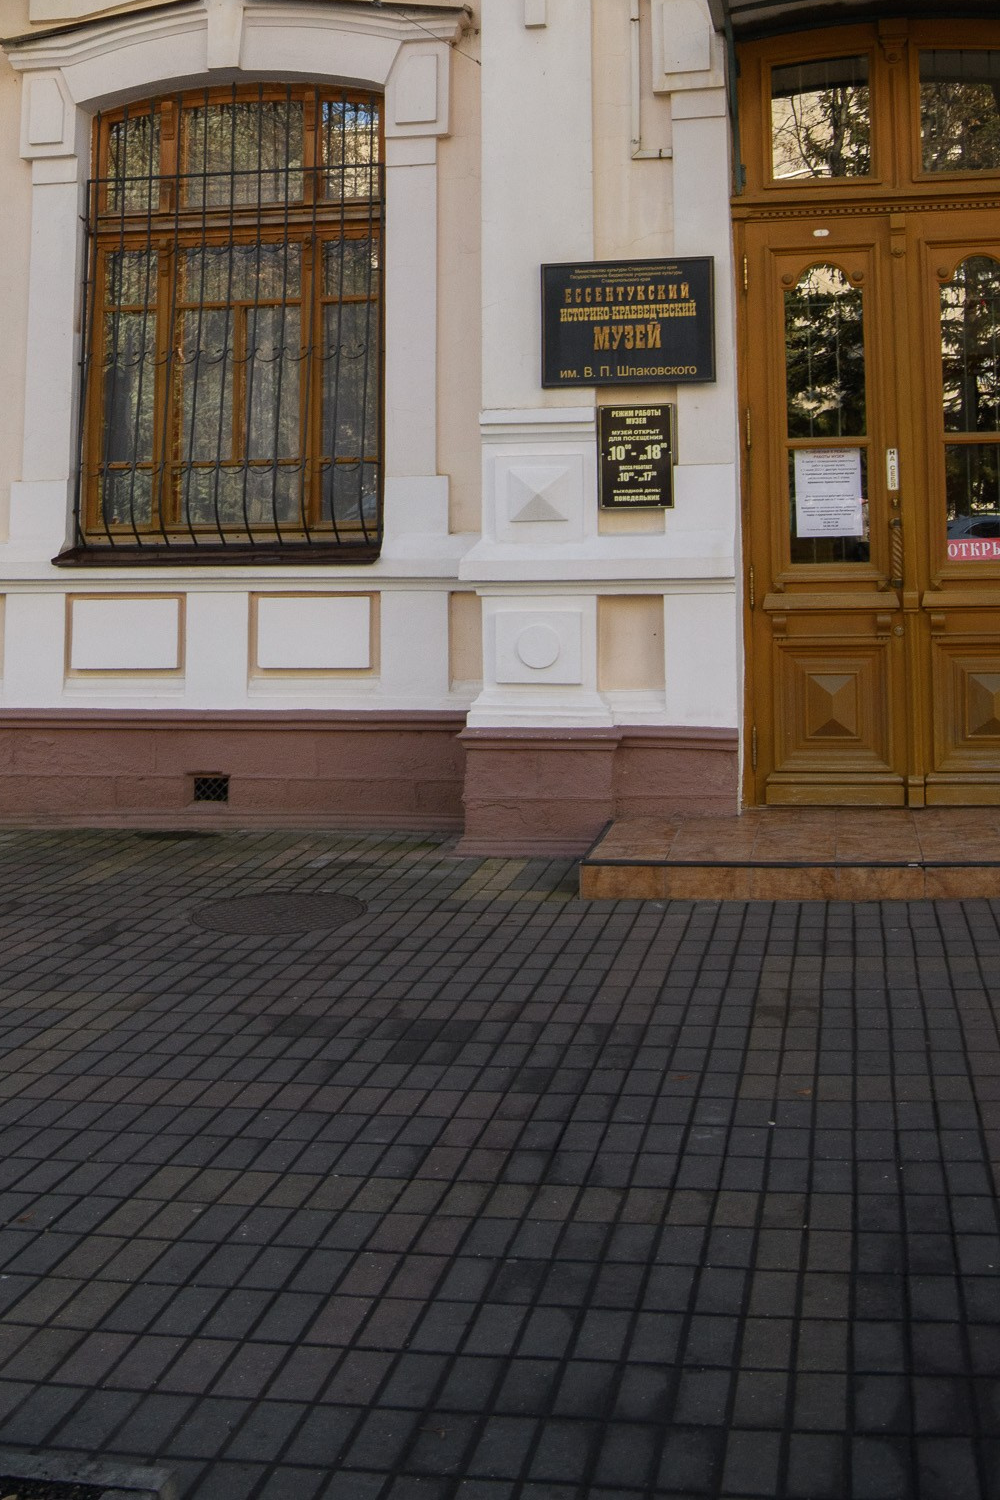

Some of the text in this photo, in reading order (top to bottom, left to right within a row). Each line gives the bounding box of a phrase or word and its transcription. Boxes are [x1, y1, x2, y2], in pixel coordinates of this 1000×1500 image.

[564, 282, 690, 304] ЕССЕНТУКСКИЙ
[560, 300, 697, 323] ИСТОРИКО-КРАЕВЕДЧЕСКИЙ
[593, 320, 662, 351] МУЗЕЙ
[560, 365, 697, 378] им. В. П. Шпаковского
[635, 409, 661, 417] РАБОТЫ
